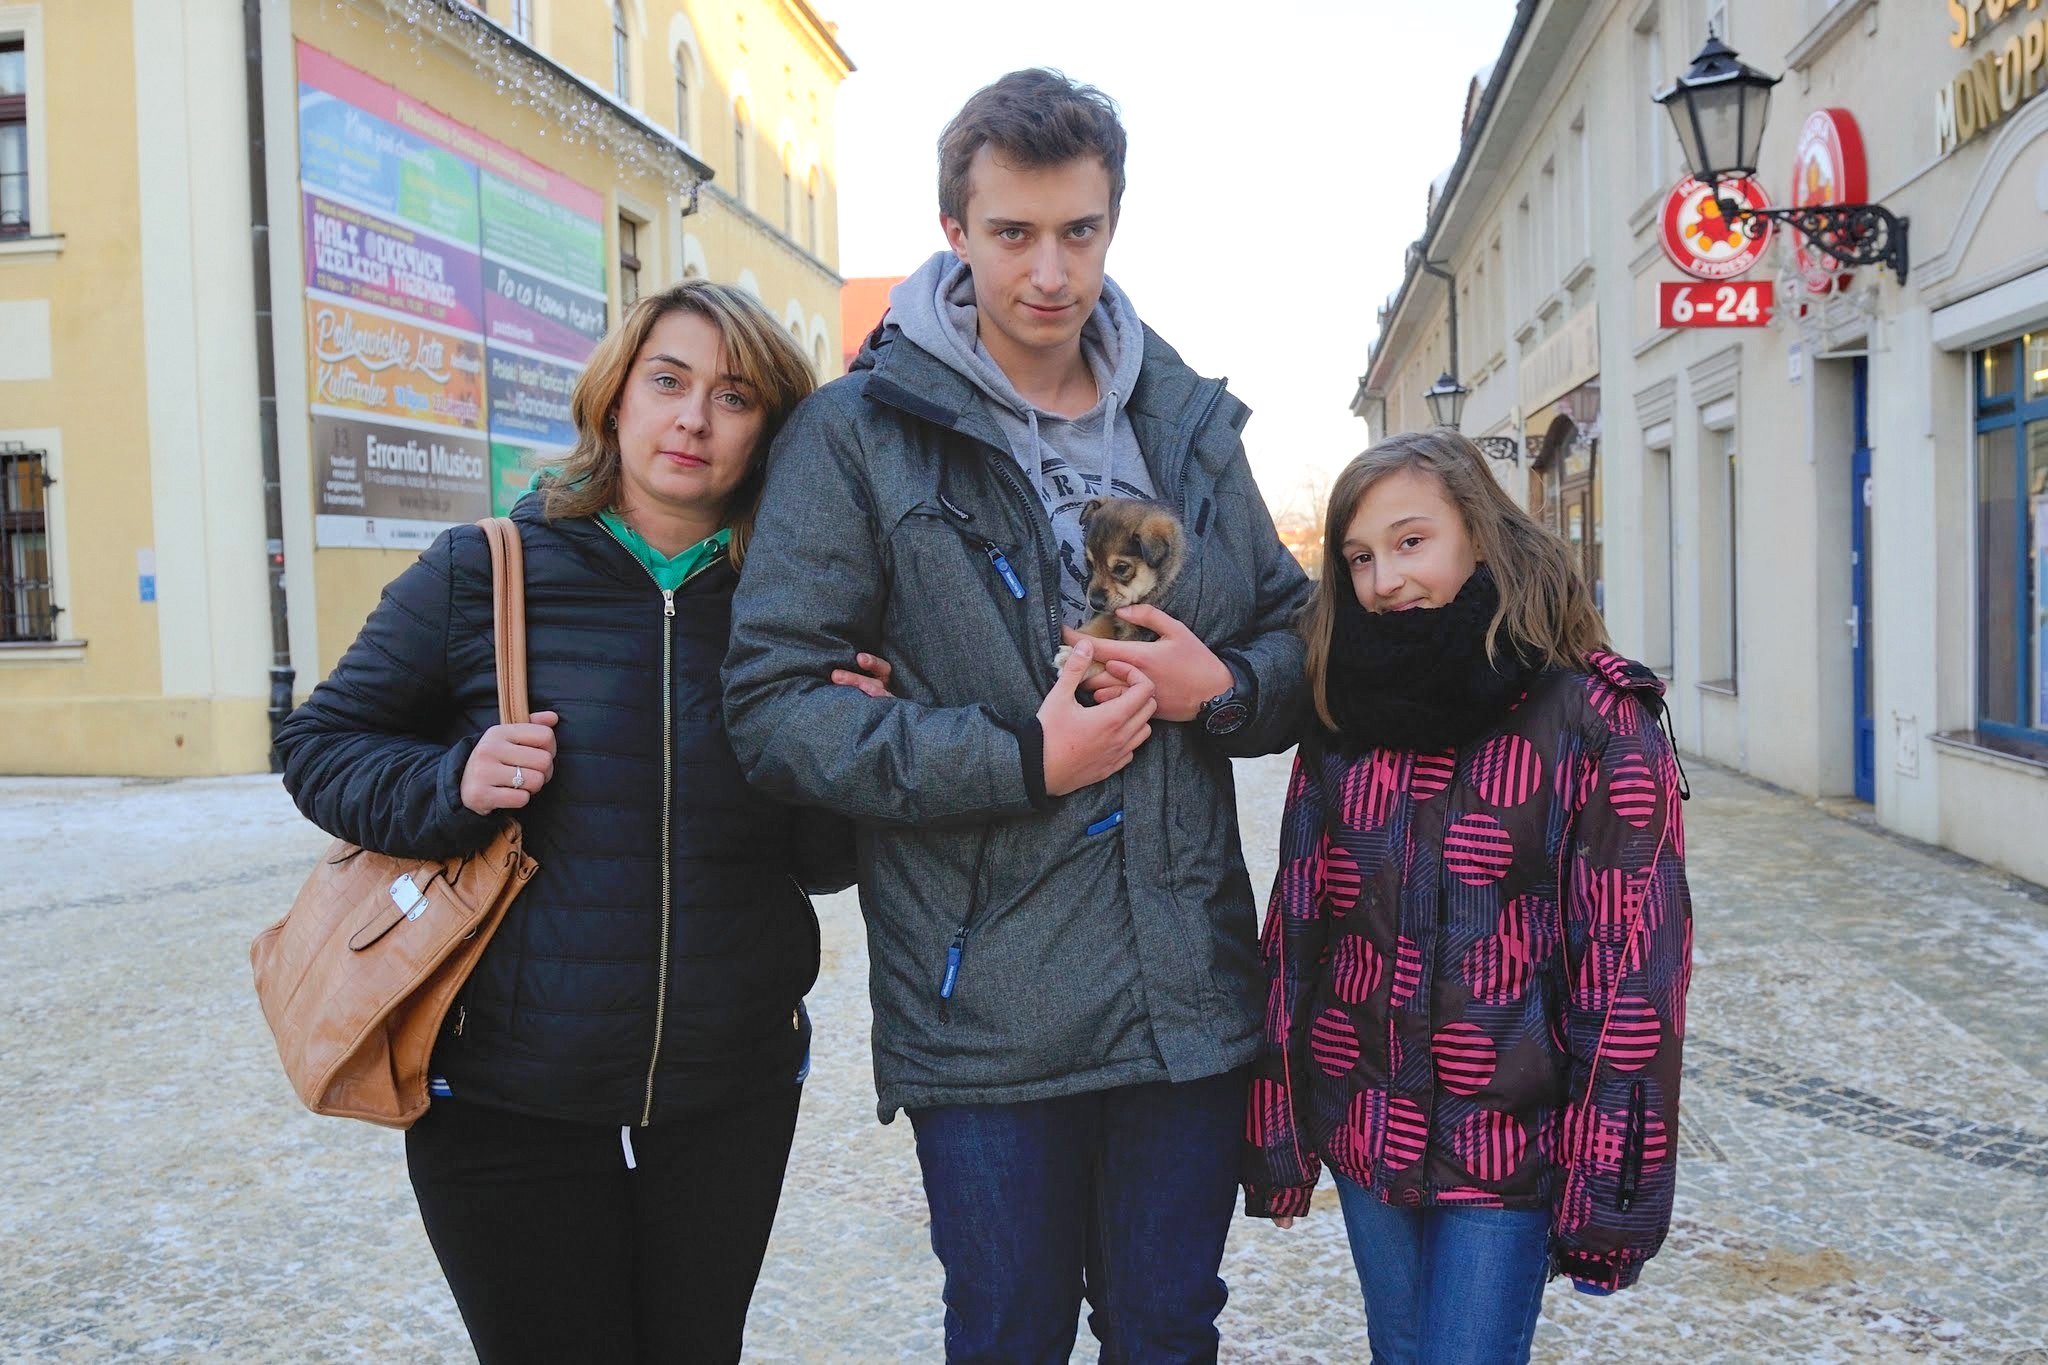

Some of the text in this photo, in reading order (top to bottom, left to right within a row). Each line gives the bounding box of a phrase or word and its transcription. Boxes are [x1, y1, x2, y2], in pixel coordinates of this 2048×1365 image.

[1936, 11, 2048, 156] MONOP
[314, 213, 359, 257] MALI
[315, 243, 389, 288] WIELKICH
[1690, 249, 1755, 277] EXPRESS
[497, 268, 514, 298] Po
[517, 283, 533, 306] co
[534, 286, 567, 321] komu
[1671, 286, 1761, 323] 6-24
[316, 309, 412, 370] Polkowickie
[366, 434, 429, 473] Errantia
[430, 443, 484, 480] Musica
